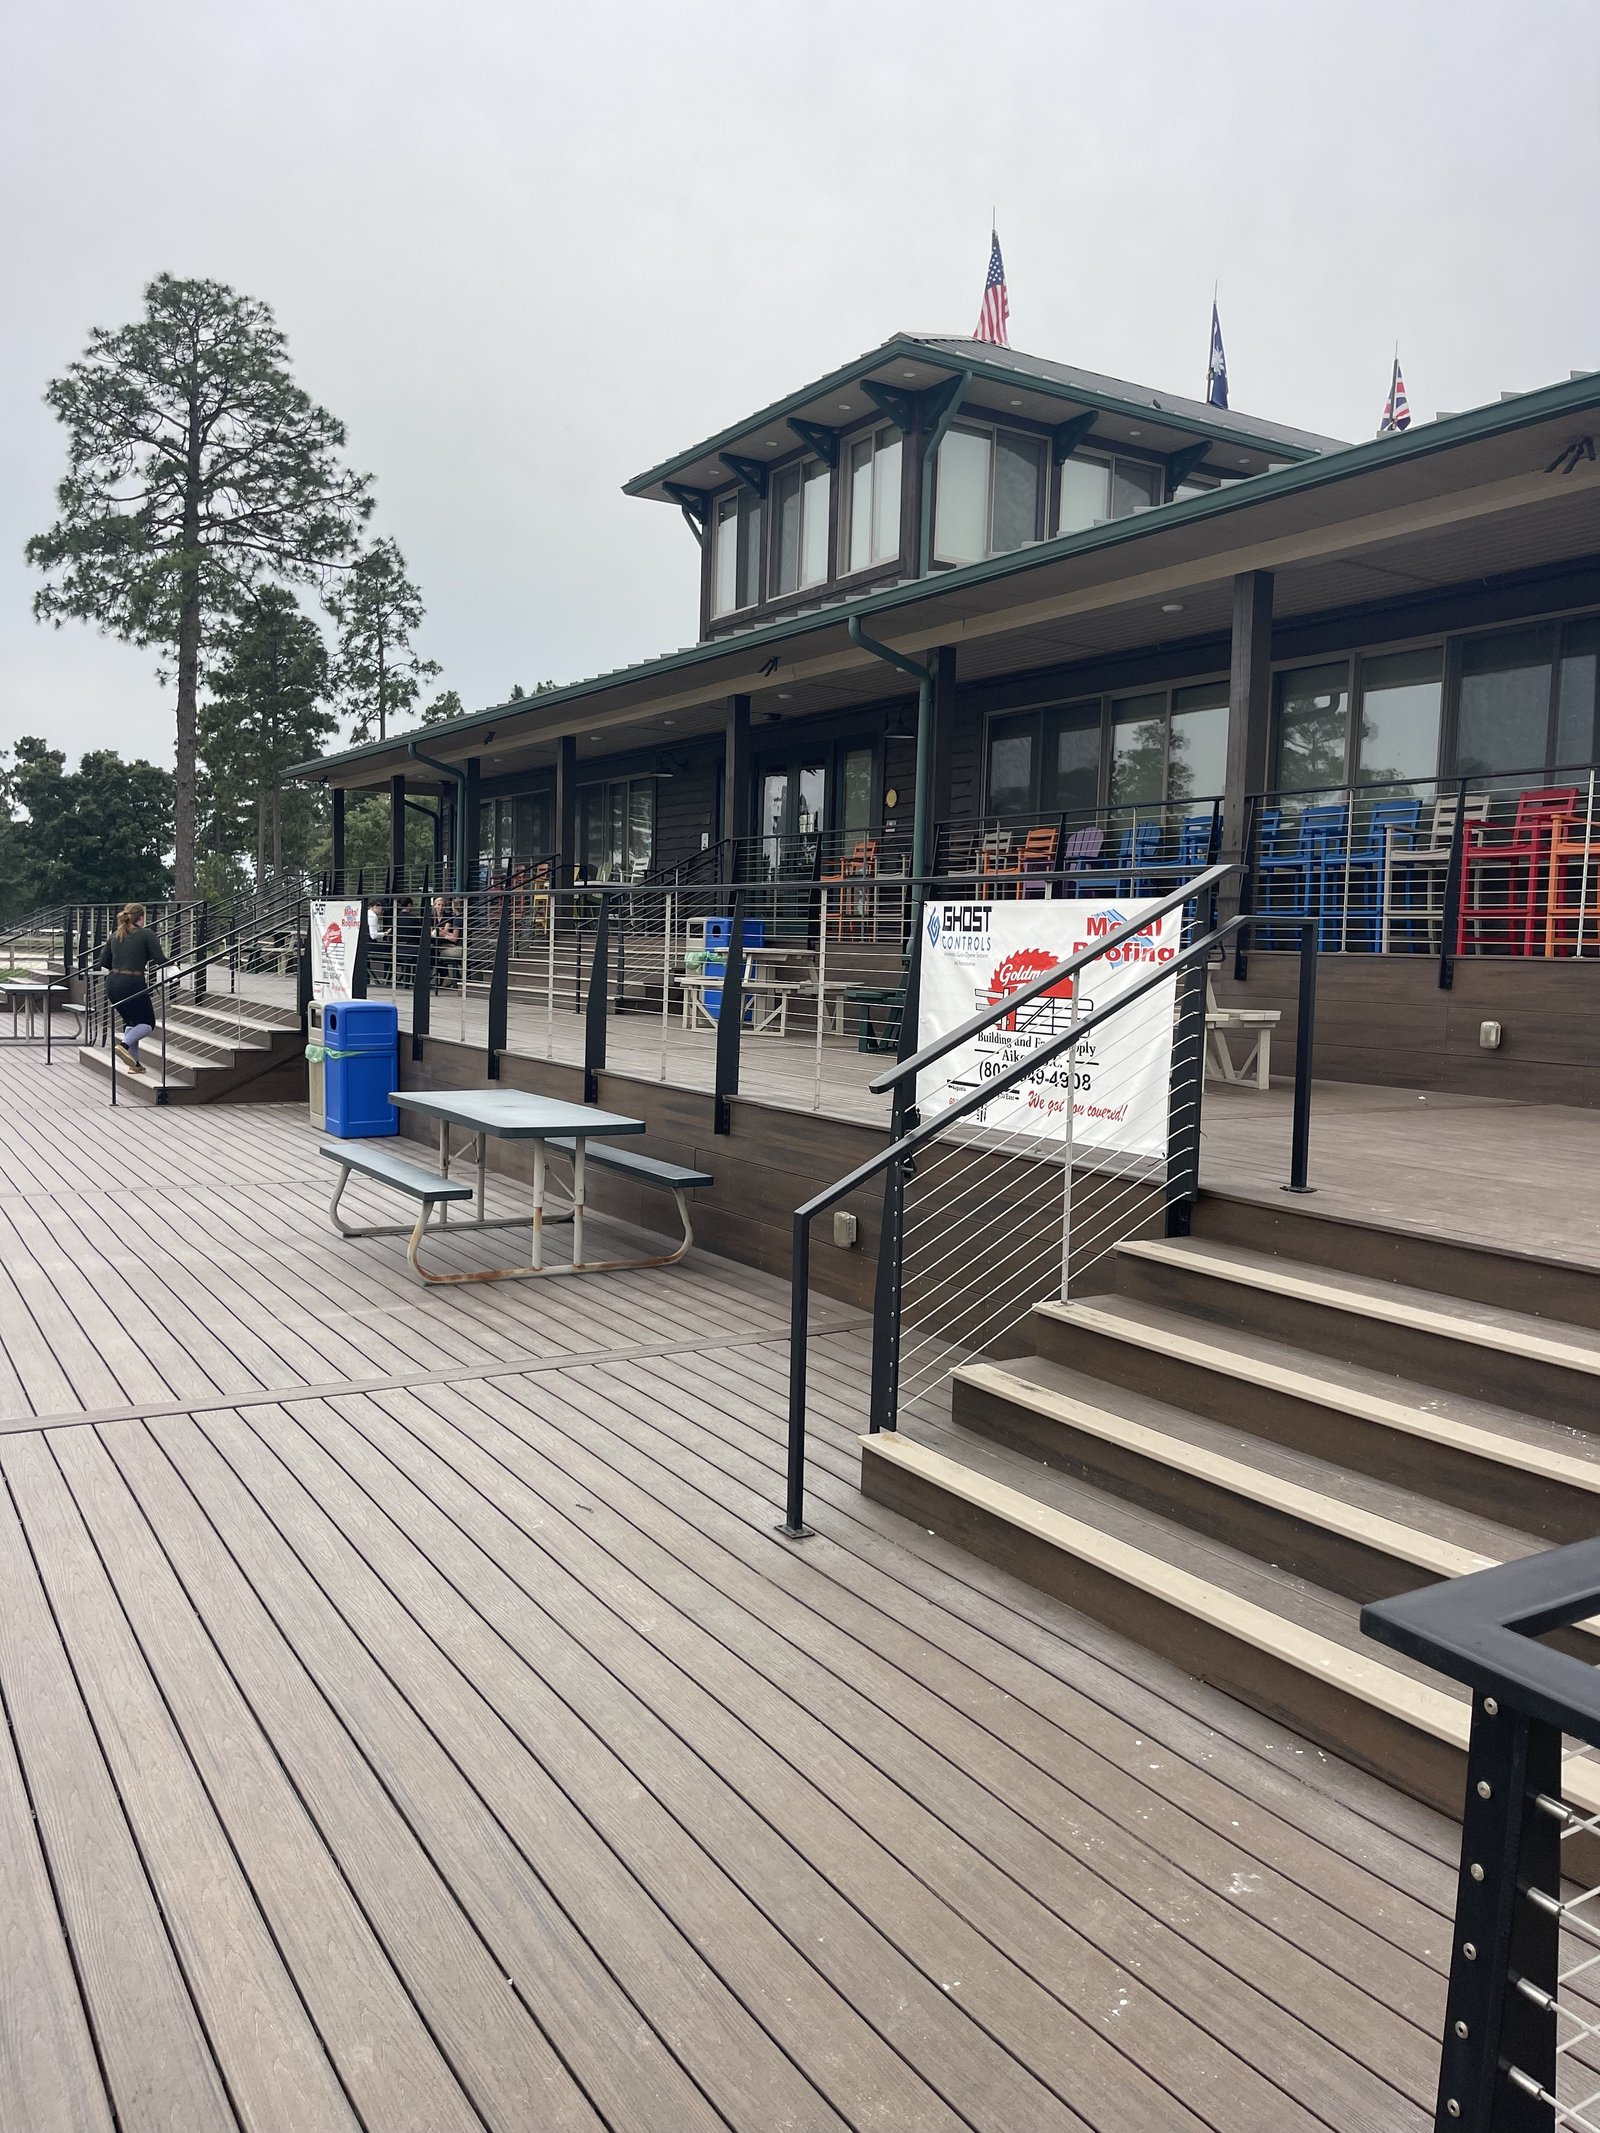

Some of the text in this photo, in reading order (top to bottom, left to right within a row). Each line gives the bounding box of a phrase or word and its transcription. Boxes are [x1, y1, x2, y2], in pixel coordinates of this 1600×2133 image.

[942, 906, 992, 932] GHOST
[1087, 918, 1162, 936] Mal
[942, 936, 991, 951] CONTROLS
[978, 1032, 1012, 1048] Building
[1015, 1036, 1031, 1048] and
[1071, 1103, 1085, 1115] ou
